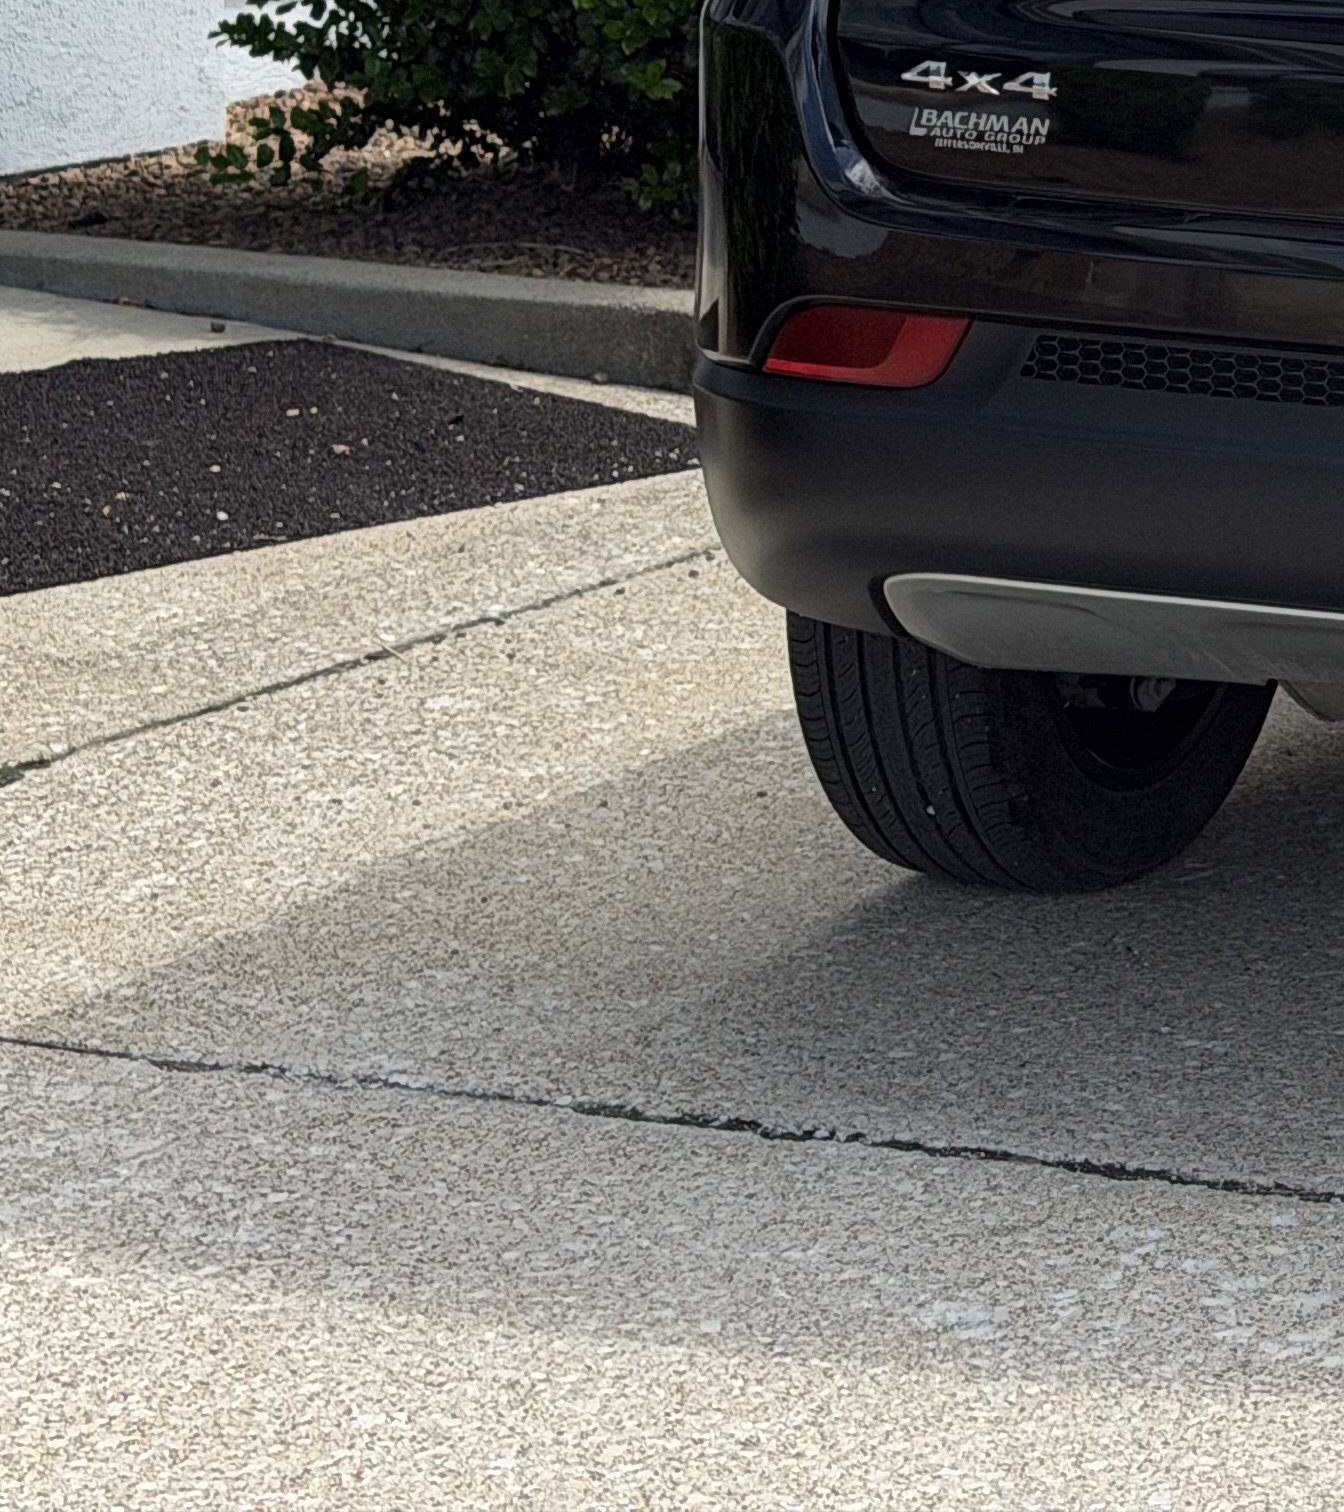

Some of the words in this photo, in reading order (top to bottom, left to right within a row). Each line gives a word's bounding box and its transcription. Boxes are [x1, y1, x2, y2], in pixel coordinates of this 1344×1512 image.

[920, 108, 1051, 136] BACHMAN
[929, 126, 978, 140] AUTO
[983, 131, 1047, 146] GROUP
